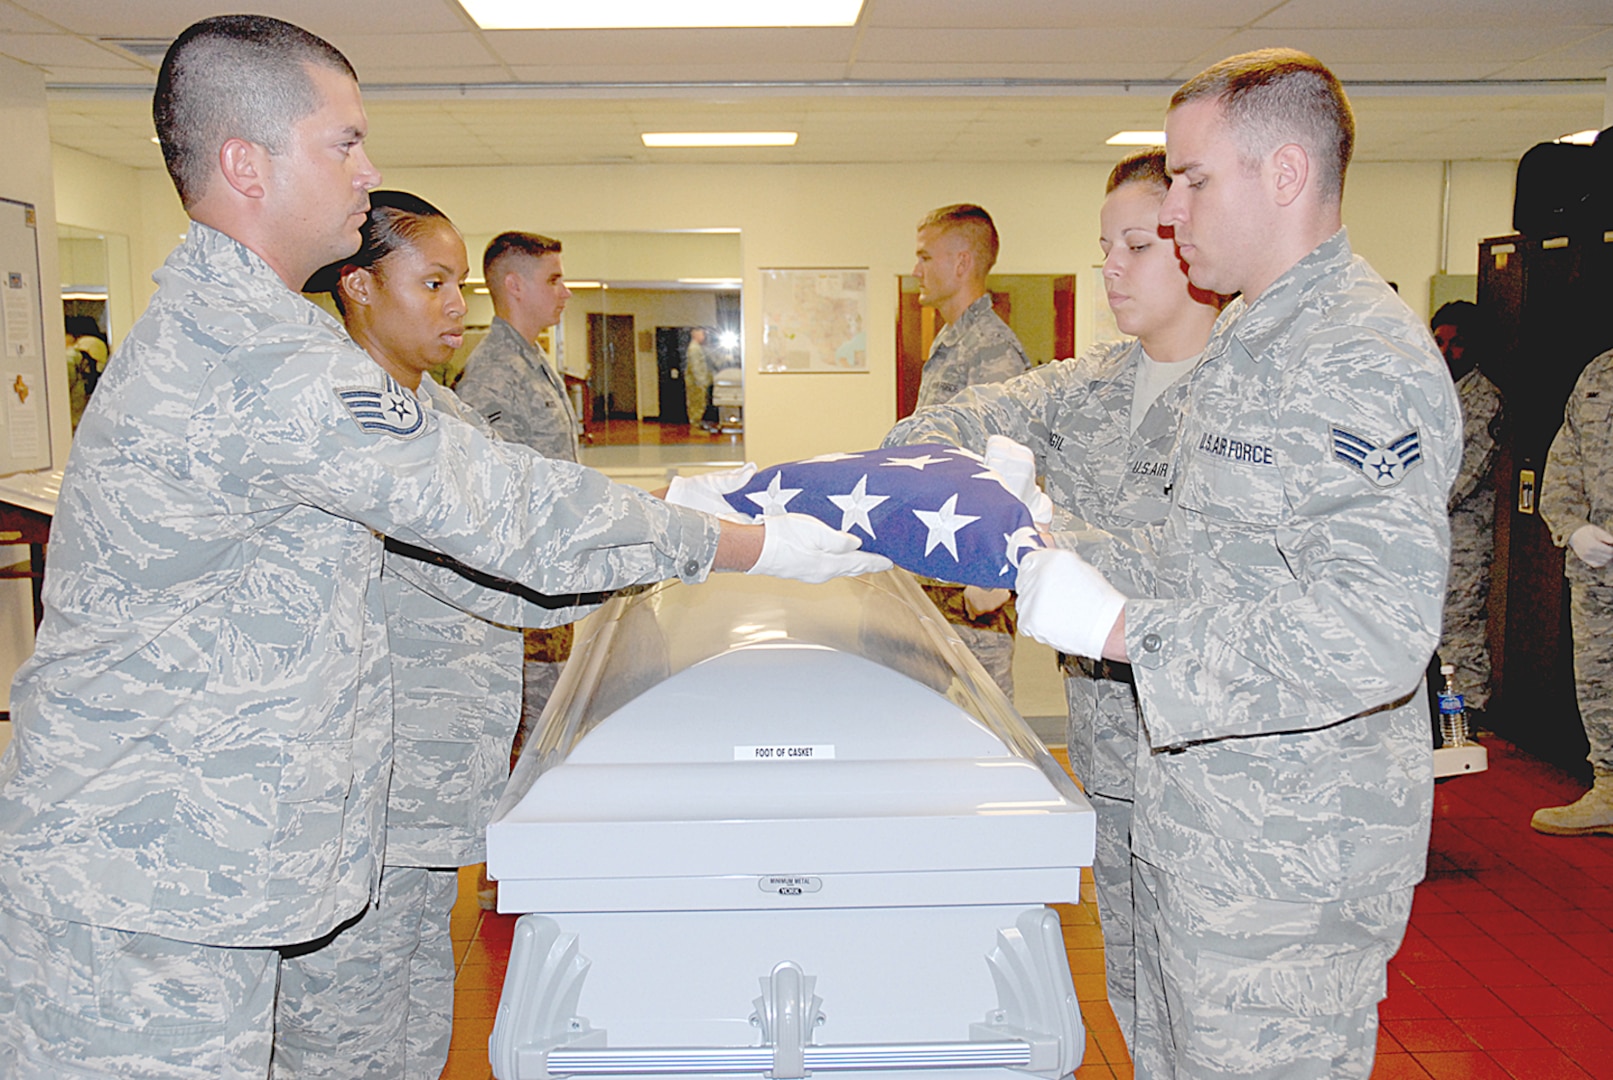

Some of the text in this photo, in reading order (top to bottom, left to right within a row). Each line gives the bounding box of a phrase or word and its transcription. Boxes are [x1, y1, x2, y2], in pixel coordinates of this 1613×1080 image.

[1049, 431, 1064, 451] GIL
[1228, 440, 1273, 464] FORCE
[755, 747, 813, 757] FOOT OF CASKET
